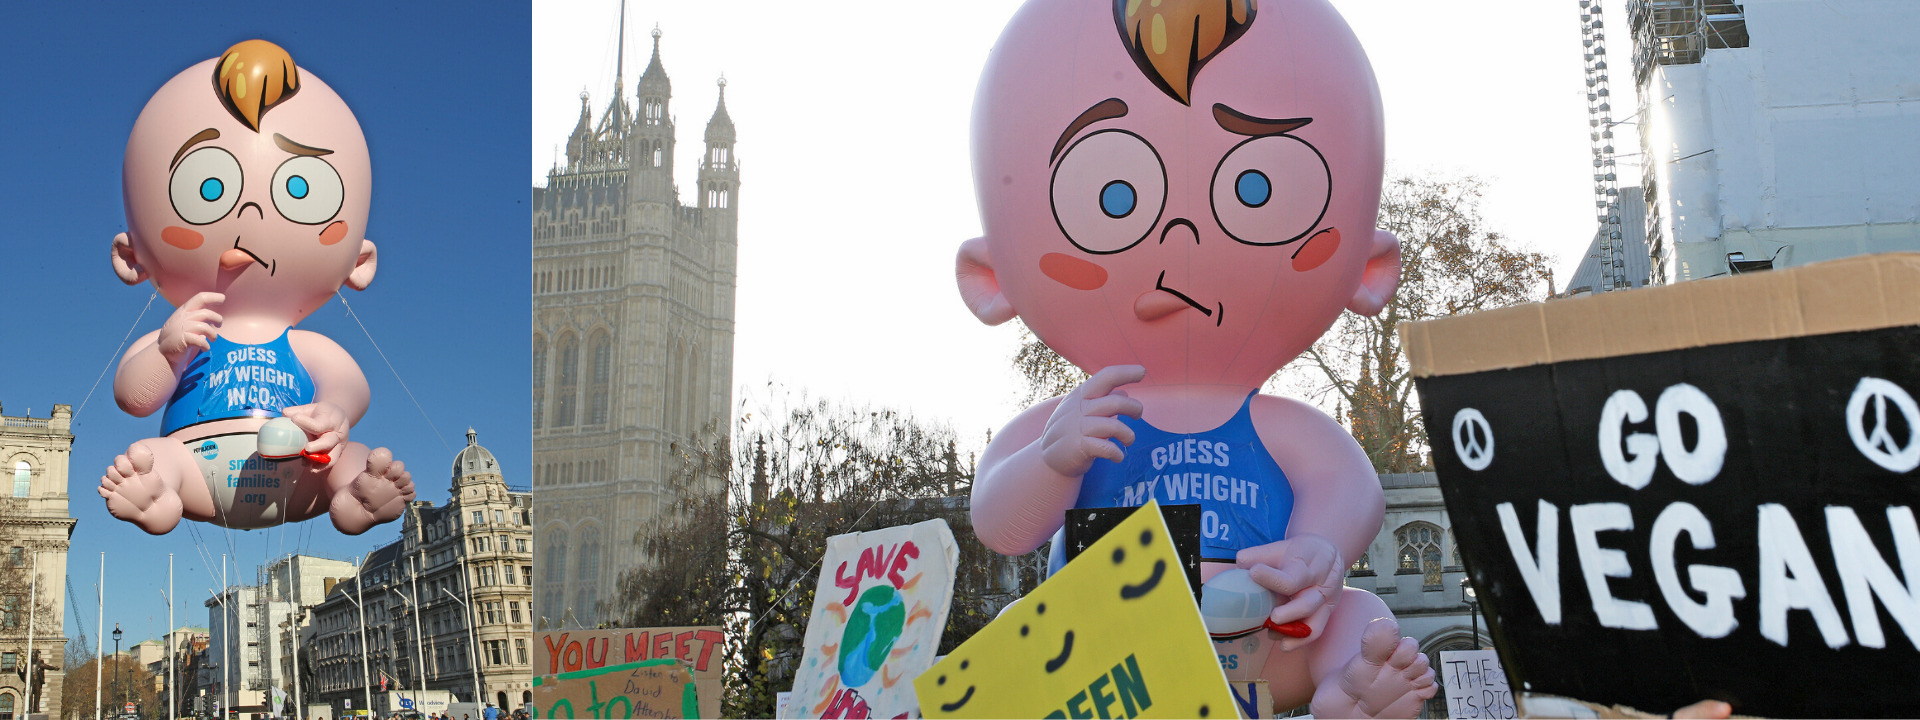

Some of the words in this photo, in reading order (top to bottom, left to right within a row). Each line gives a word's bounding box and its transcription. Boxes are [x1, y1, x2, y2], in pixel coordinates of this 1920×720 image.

[227, 346, 277, 364] GUESS
[209, 366, 232, 388] MY
[234, 365, 295, 390] WEIGHT
[227, 387, 246, 407] IN
[1598, 382, 1728, 491] GO
[228, 455, 279, 472] smaller
[1151, 438, 1230, 470] GUESS
[226, 474, 281, 489] families
[1122, 474, 1161, 508] MY
[1163, 472, 1260, 509] WEIGHT
[240, 493, 267, 506] .org
[1201, 510, 1229, 541] O2
[834, 540, 921, 608] SAVE
[1496, 499, 1920, 651] VEGAN
[543, 632, 609, 674] YOU
[625, 630, 723, 672] MEET
[623, 679, 662, 698] David
[631, 667, 663, 680] Listen
[670, 672, 680, 684] to
[1445, 658, 1495, 690] THE
[1452, 695, 1480, 720] IS
[1482, 689, 1518, 720] RIS
